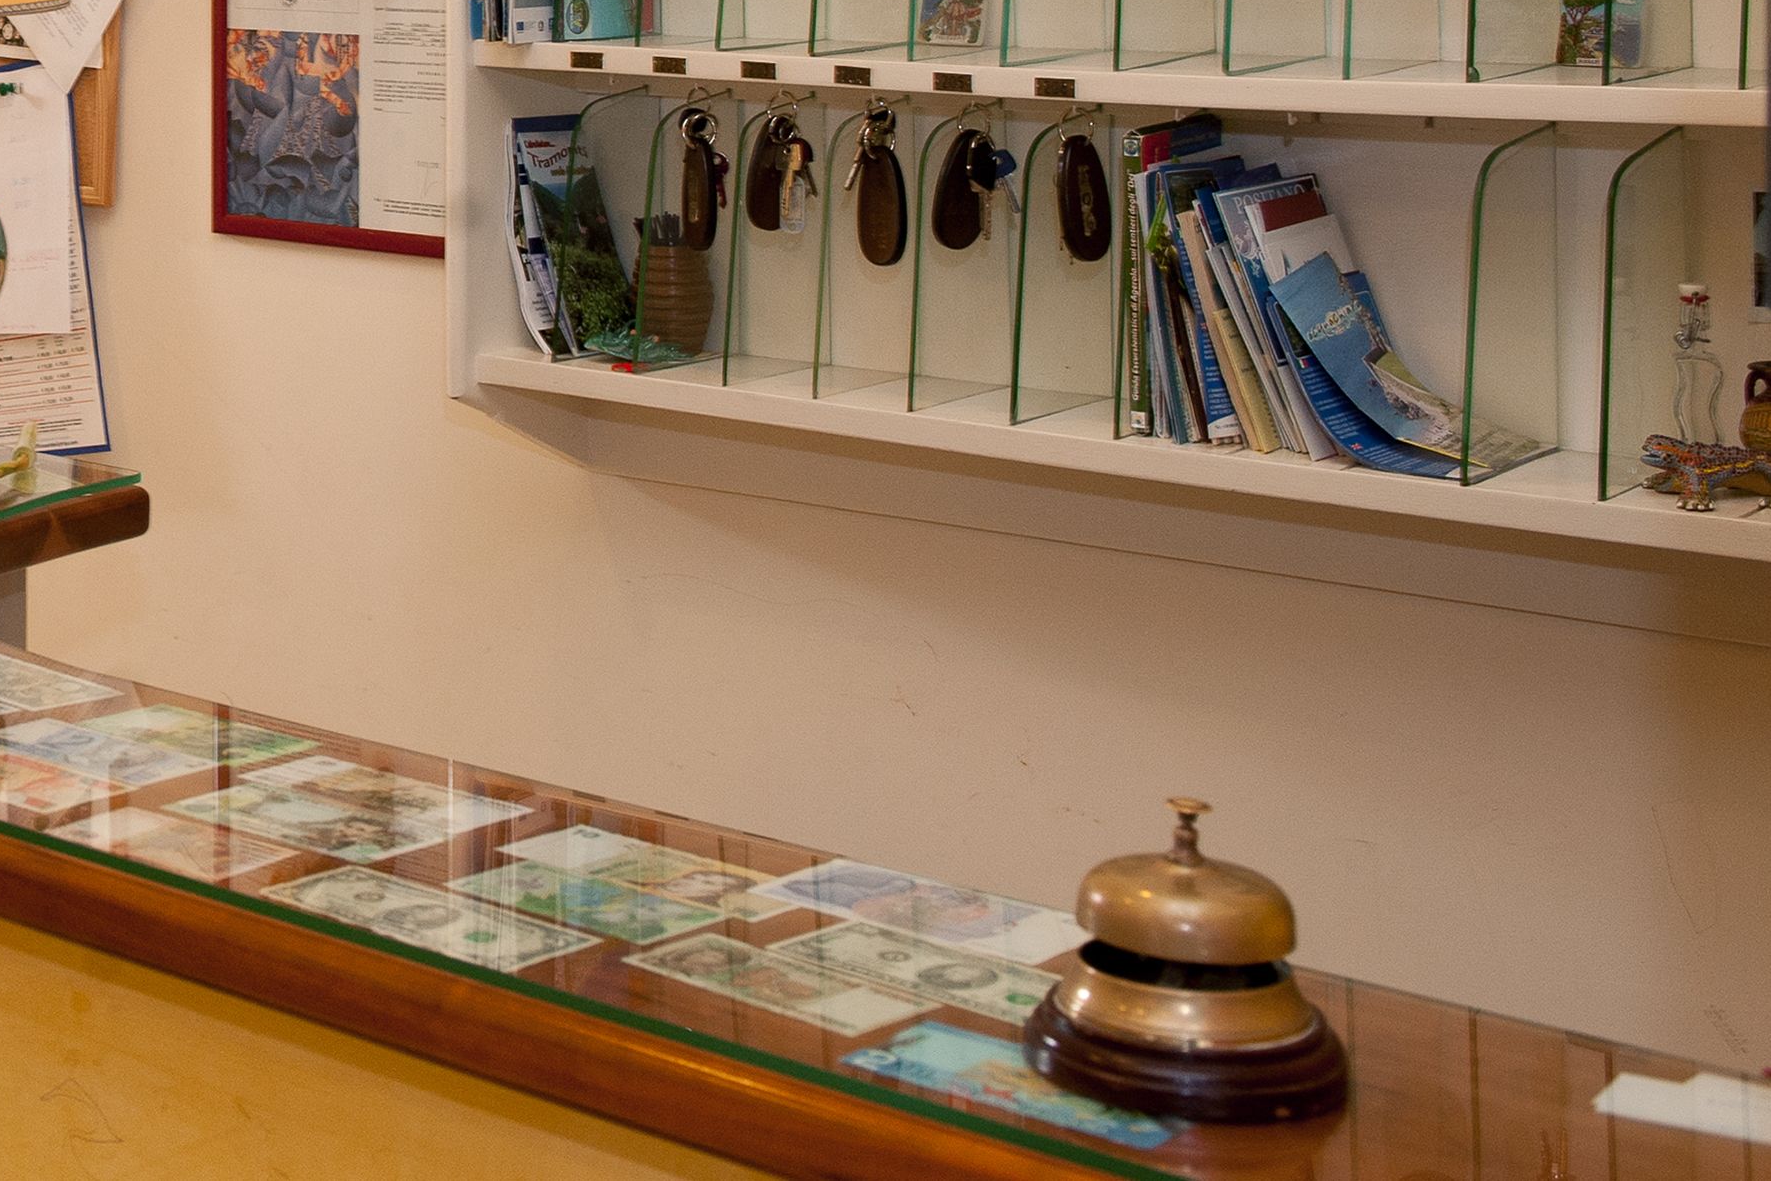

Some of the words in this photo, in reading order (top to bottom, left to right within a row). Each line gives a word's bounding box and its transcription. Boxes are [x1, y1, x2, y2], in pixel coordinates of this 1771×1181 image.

[1128, 215, 1138, 247] sentieri
[1129, 247, 1138, 261] sui
[1129, 376, 1140, 401] Guida
